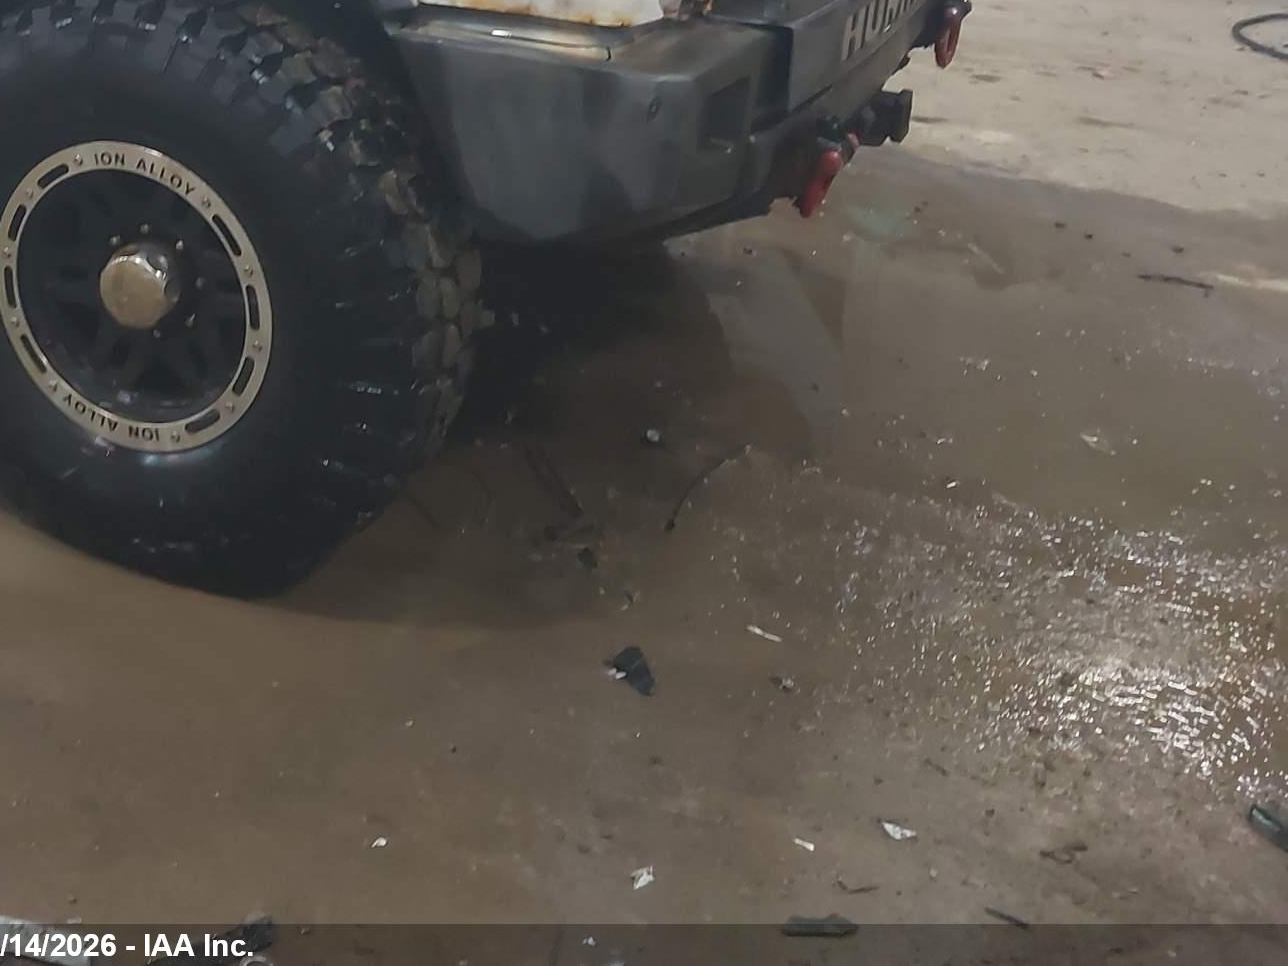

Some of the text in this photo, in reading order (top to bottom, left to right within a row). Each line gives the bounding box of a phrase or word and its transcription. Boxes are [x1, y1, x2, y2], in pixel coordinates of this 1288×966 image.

[94, 152, 195, 195] ION ALLOY
[63, 393, 160, 442] ION ALLOY
